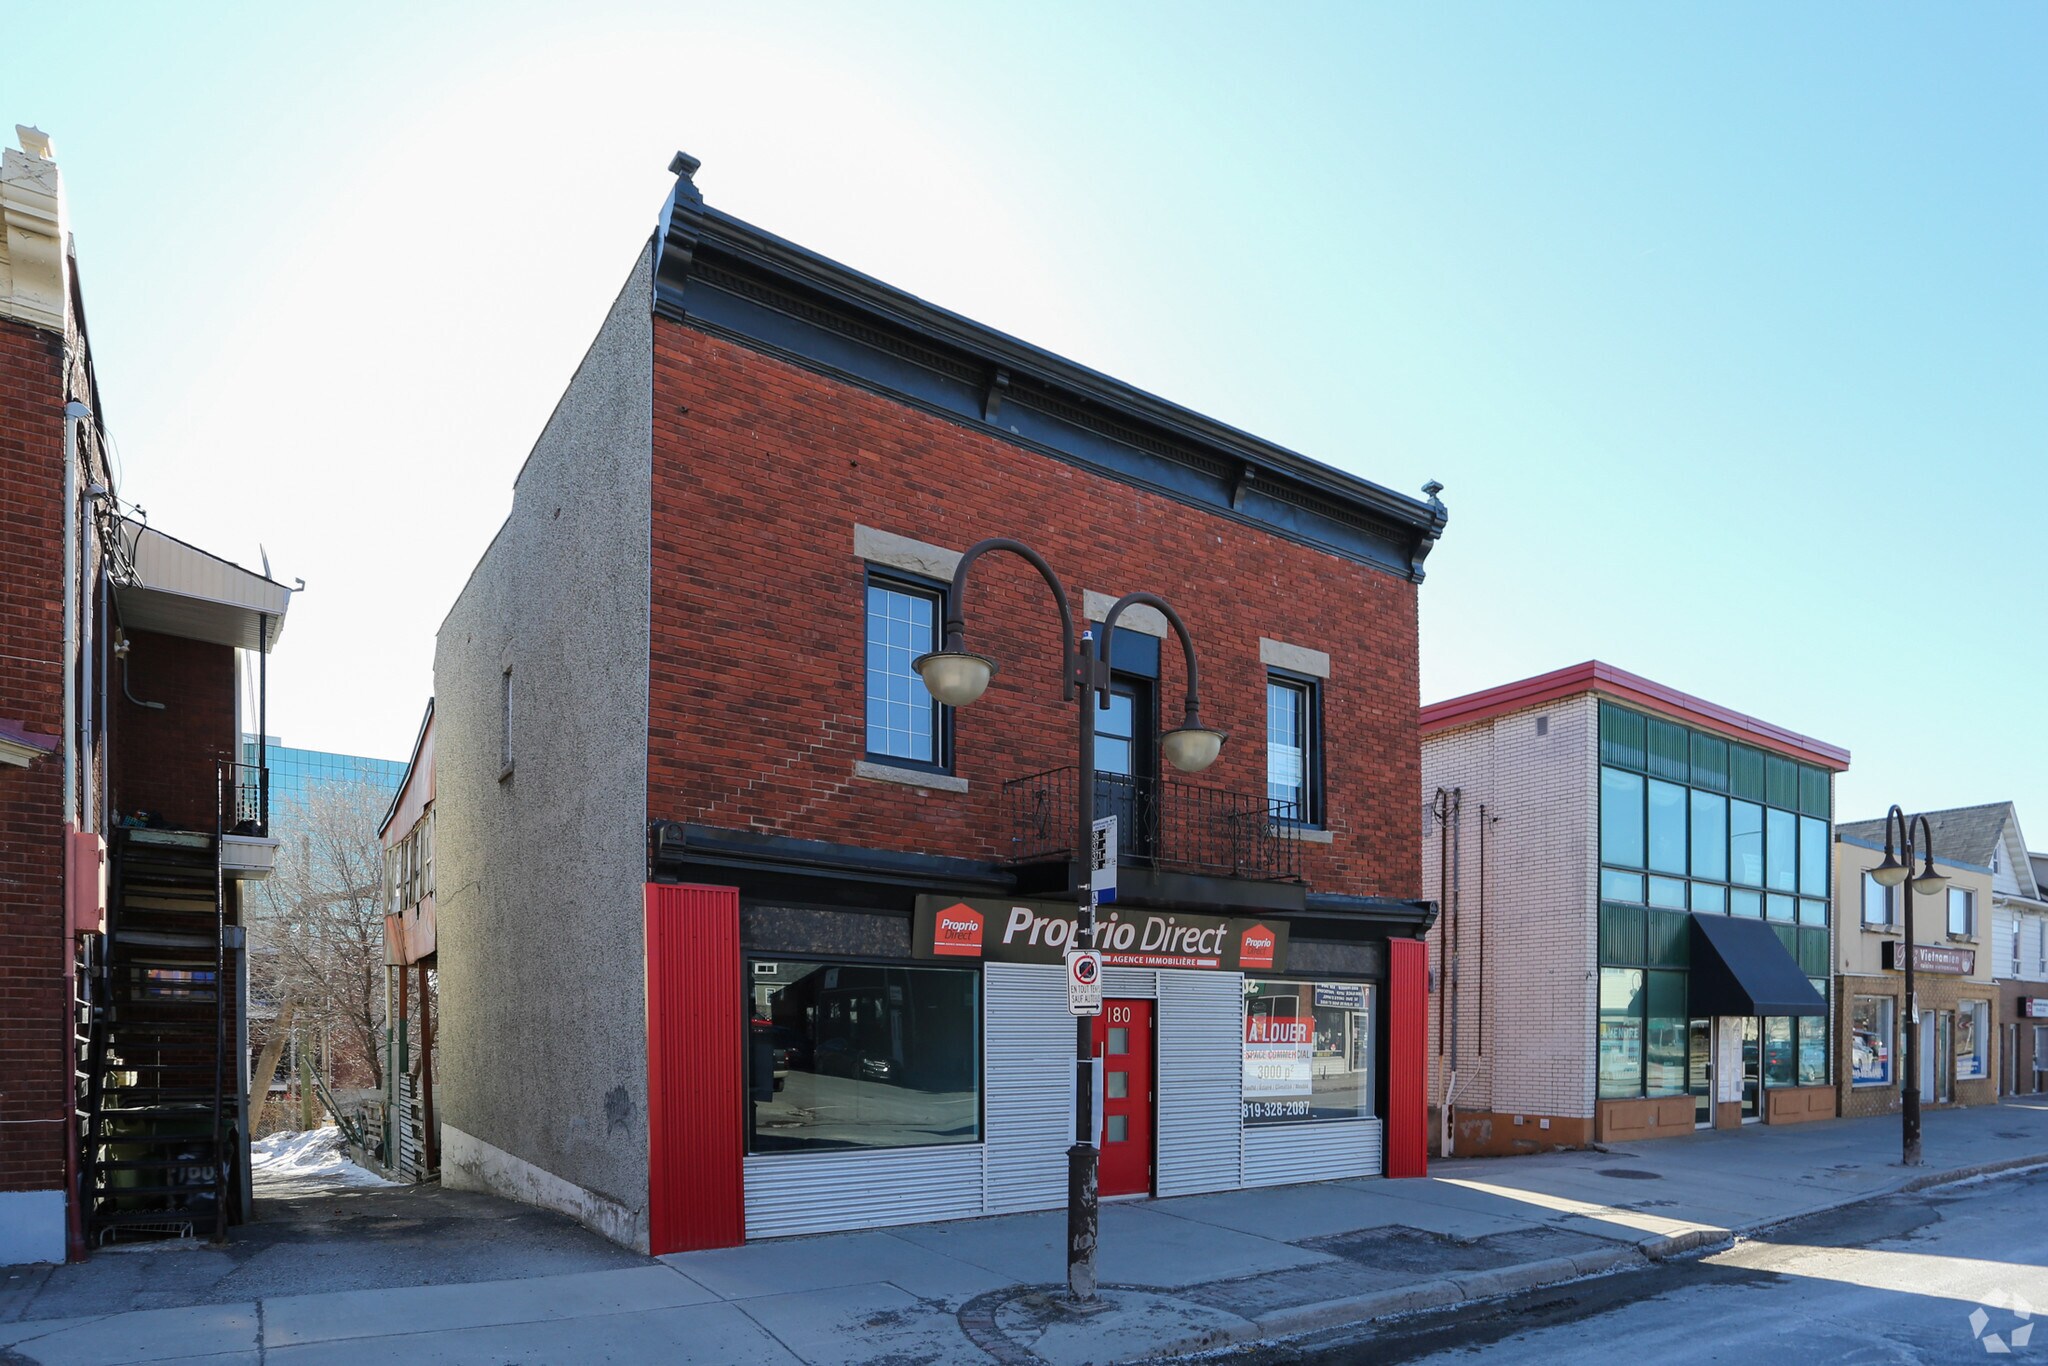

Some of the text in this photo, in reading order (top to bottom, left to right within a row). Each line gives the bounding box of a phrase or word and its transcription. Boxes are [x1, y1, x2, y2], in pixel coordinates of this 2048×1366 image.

[941, 918, 979, 932] Proprio
[945, 929, 972, 940] Direct
[1140, 916, 1228, 955] Direct
[1245, 937, 1272, 949] Proprio
[1112, 955, 1196, 966] AGENCE IMMOBILIÈRE
[1920, 949, 1960, 964] Vietnamien
[1071, 985, 1077, 994] EN
[1078, 985, 1089, 994] TOUT
[1071, 994, 1084, 1004] SAUF
[1107, 1006, 1131, 1023] 180
[1262, 1023, 1307, 1042] LOUER
[1244, 1050, 1266, 1060] SPACE
[1257, 1065, 1282, 1079] 3000
[1243, 1101, 1310, 1118] 819-328-2087
